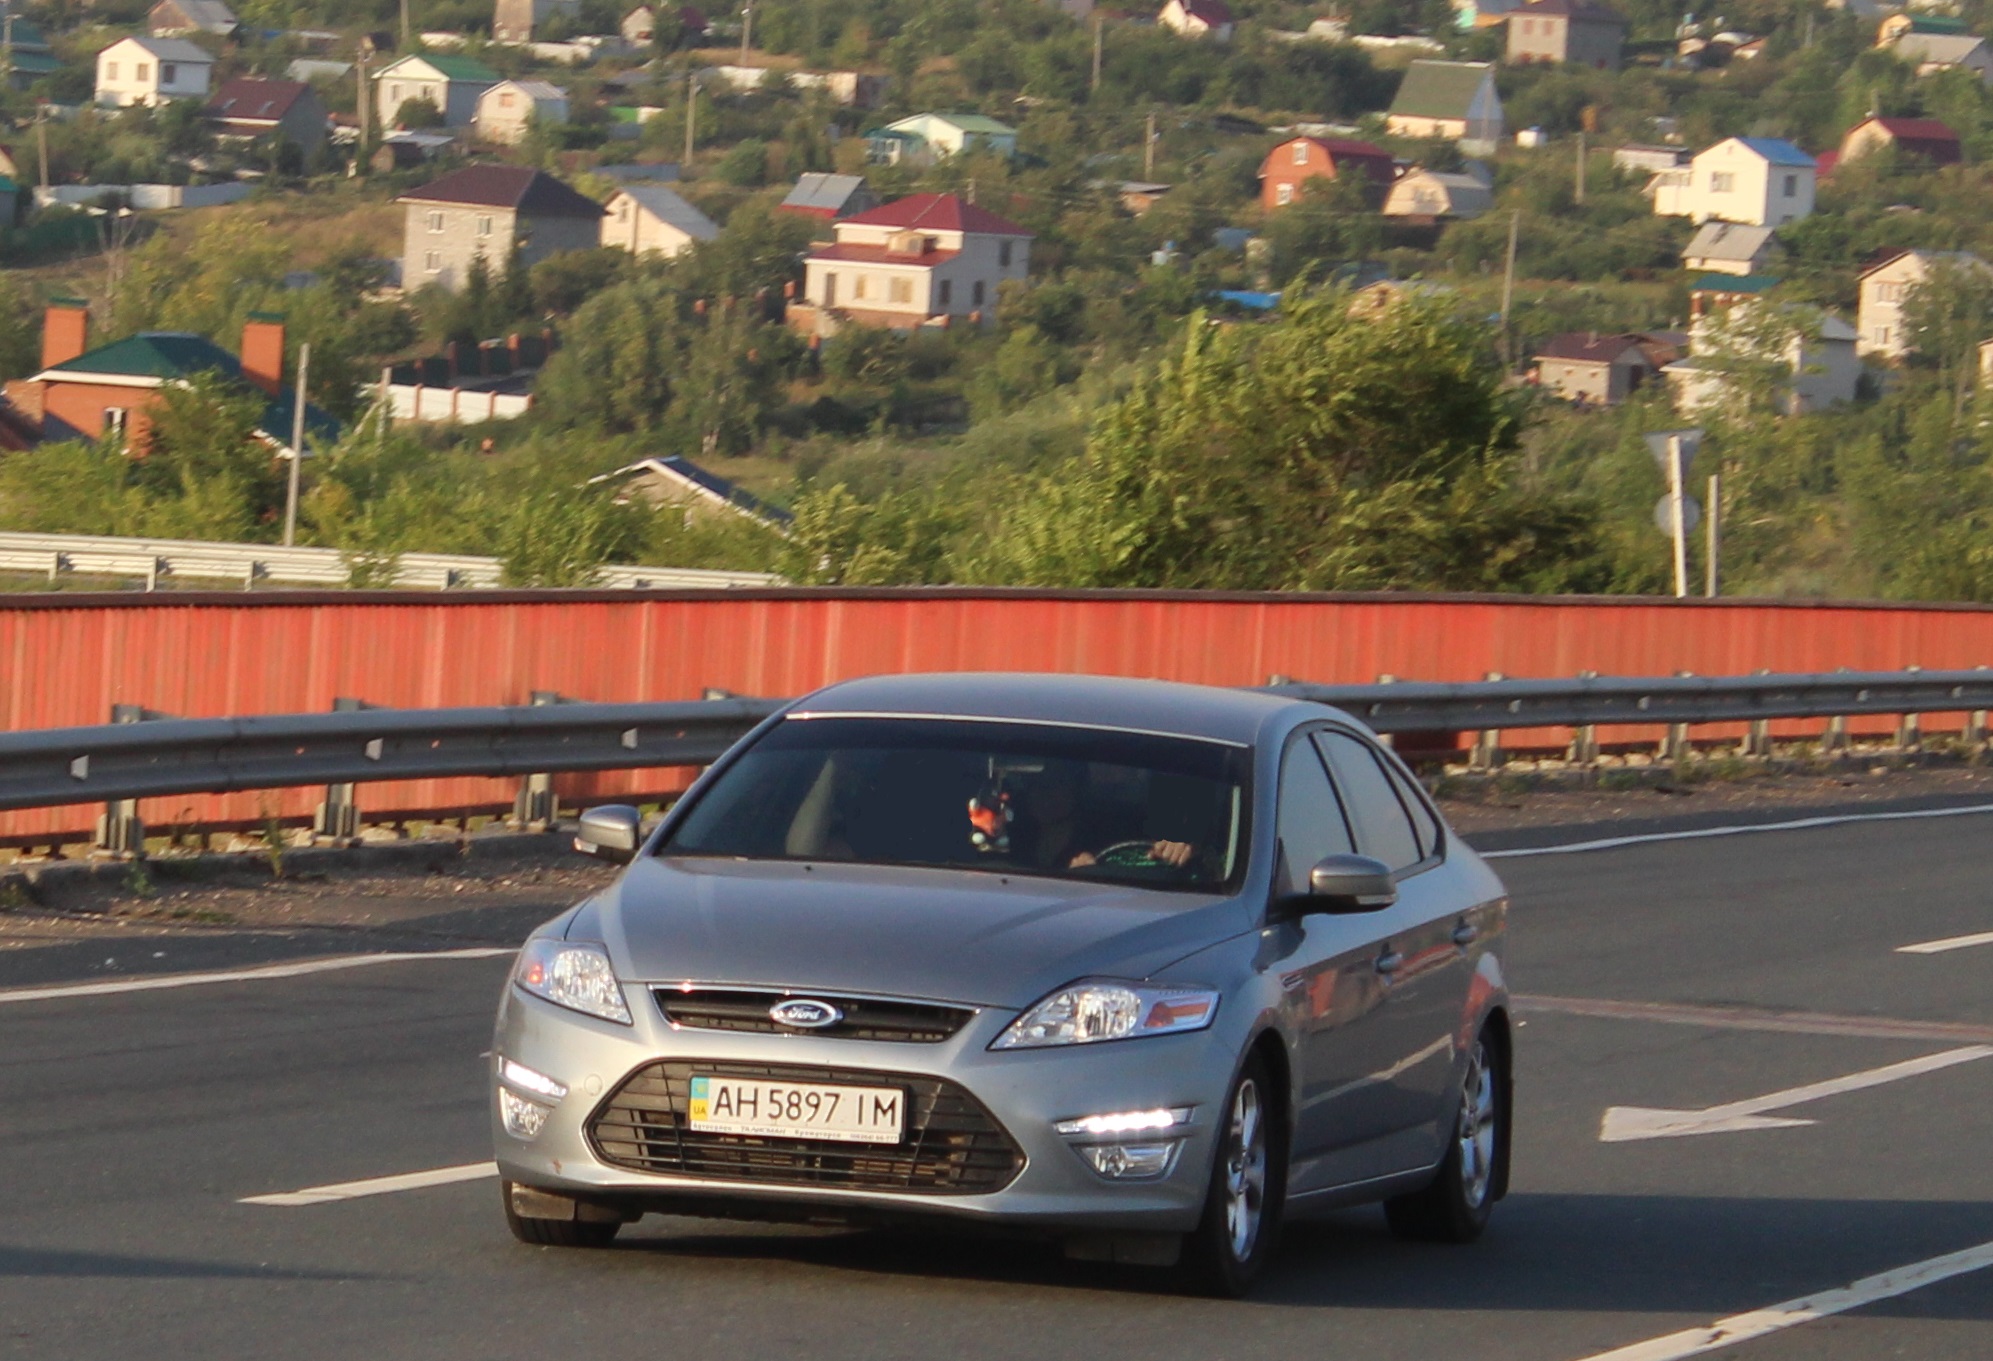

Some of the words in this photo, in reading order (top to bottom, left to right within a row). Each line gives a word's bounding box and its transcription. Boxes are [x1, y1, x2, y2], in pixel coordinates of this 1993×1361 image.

[787, 1006, 821, 1020] Ford
[693, 1105, 707, 1116] UA
[713, 1085, 758, 1118] AH
[768, 1089, 841, 1123] 5897
[857, 1094, 897, 1127] IM
